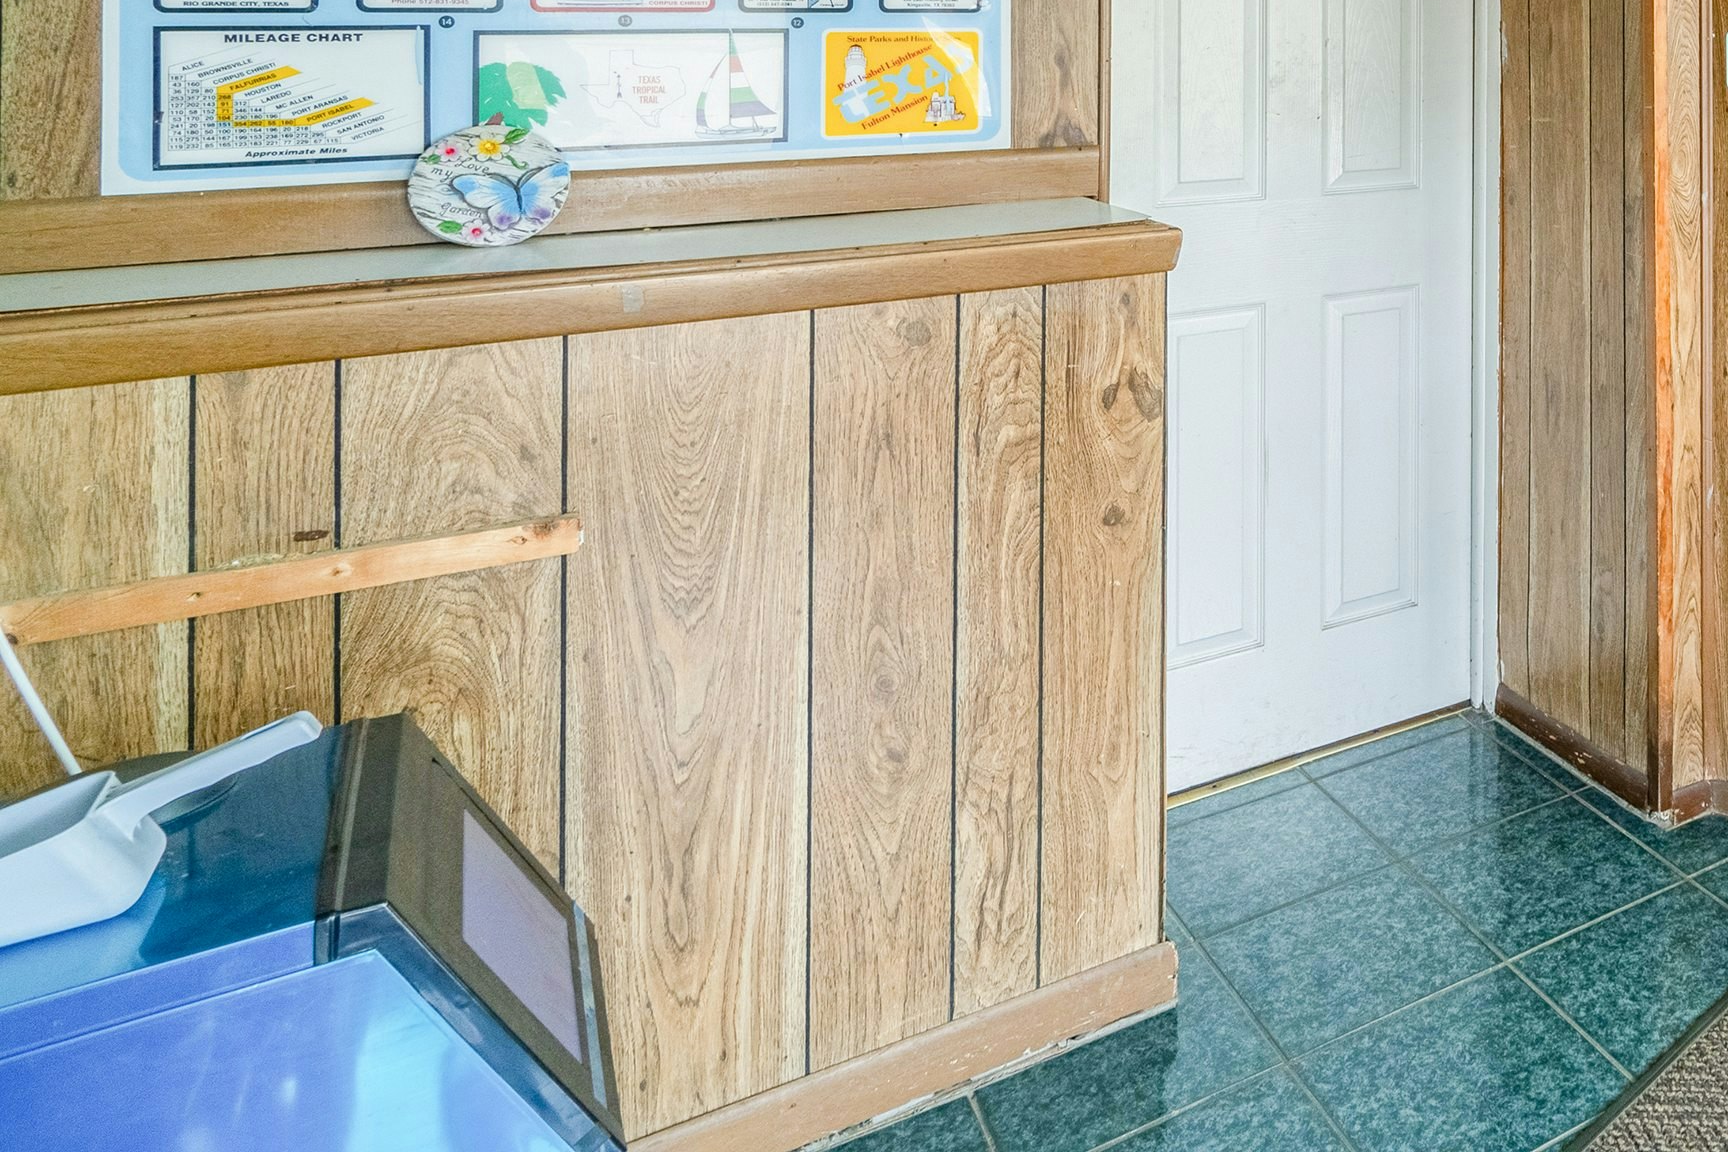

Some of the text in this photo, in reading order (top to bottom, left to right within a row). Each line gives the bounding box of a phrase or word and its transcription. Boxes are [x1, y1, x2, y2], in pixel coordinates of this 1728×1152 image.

[224, 33, 363, 43] MILEAGE CHART
[182, 61, 204, 71] ALICE
[198, 59, 253, 78] BROWNSVILLE
[859, 65, 885, 82] Isabel
[885, 45, 932, 69] Lighthouse
[638, 75, 661, 84] TEXAS
[244, 83, 282, 98] HOUSTON
[260, 90, 292, 104] LAREDO
[632, 86, 666, 94] TROPICAL
[640, 95, 659, 104] TRAIL
[861, 95, 928, 130] Fulton Mansion
[351, 126, 384, 141] VICTORIA
[245, 147, 348, 158] Approximate Miles
[455, 157, 490, 175] Love
[431, 167, 453, 184] my
